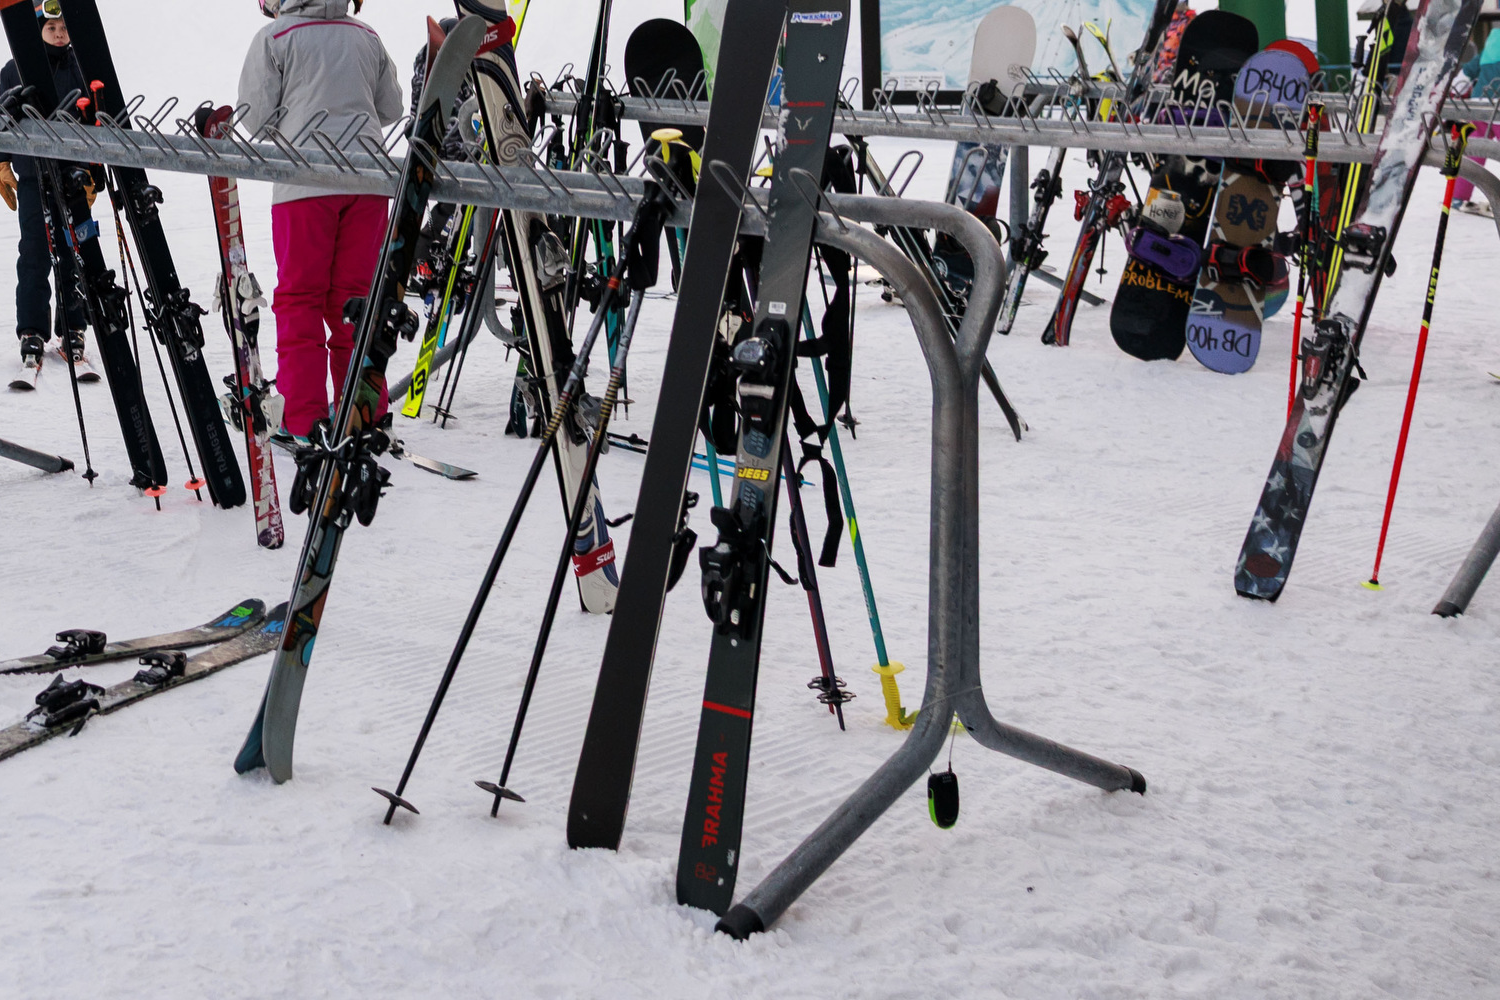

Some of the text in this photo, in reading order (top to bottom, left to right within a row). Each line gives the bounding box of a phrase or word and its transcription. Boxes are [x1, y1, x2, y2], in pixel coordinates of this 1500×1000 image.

[1243, 67, 1309, 104] DB400
[1150, 205, 1182, 220] HONEY
[1427, 266, 1439, 305] LEKI
[408, 368, 427, 401] 13
[206, 421, 228, 473] RANGER
[737, 467, 770, 481] JEGS
[701, 751, 729, 849] BRAHMA
